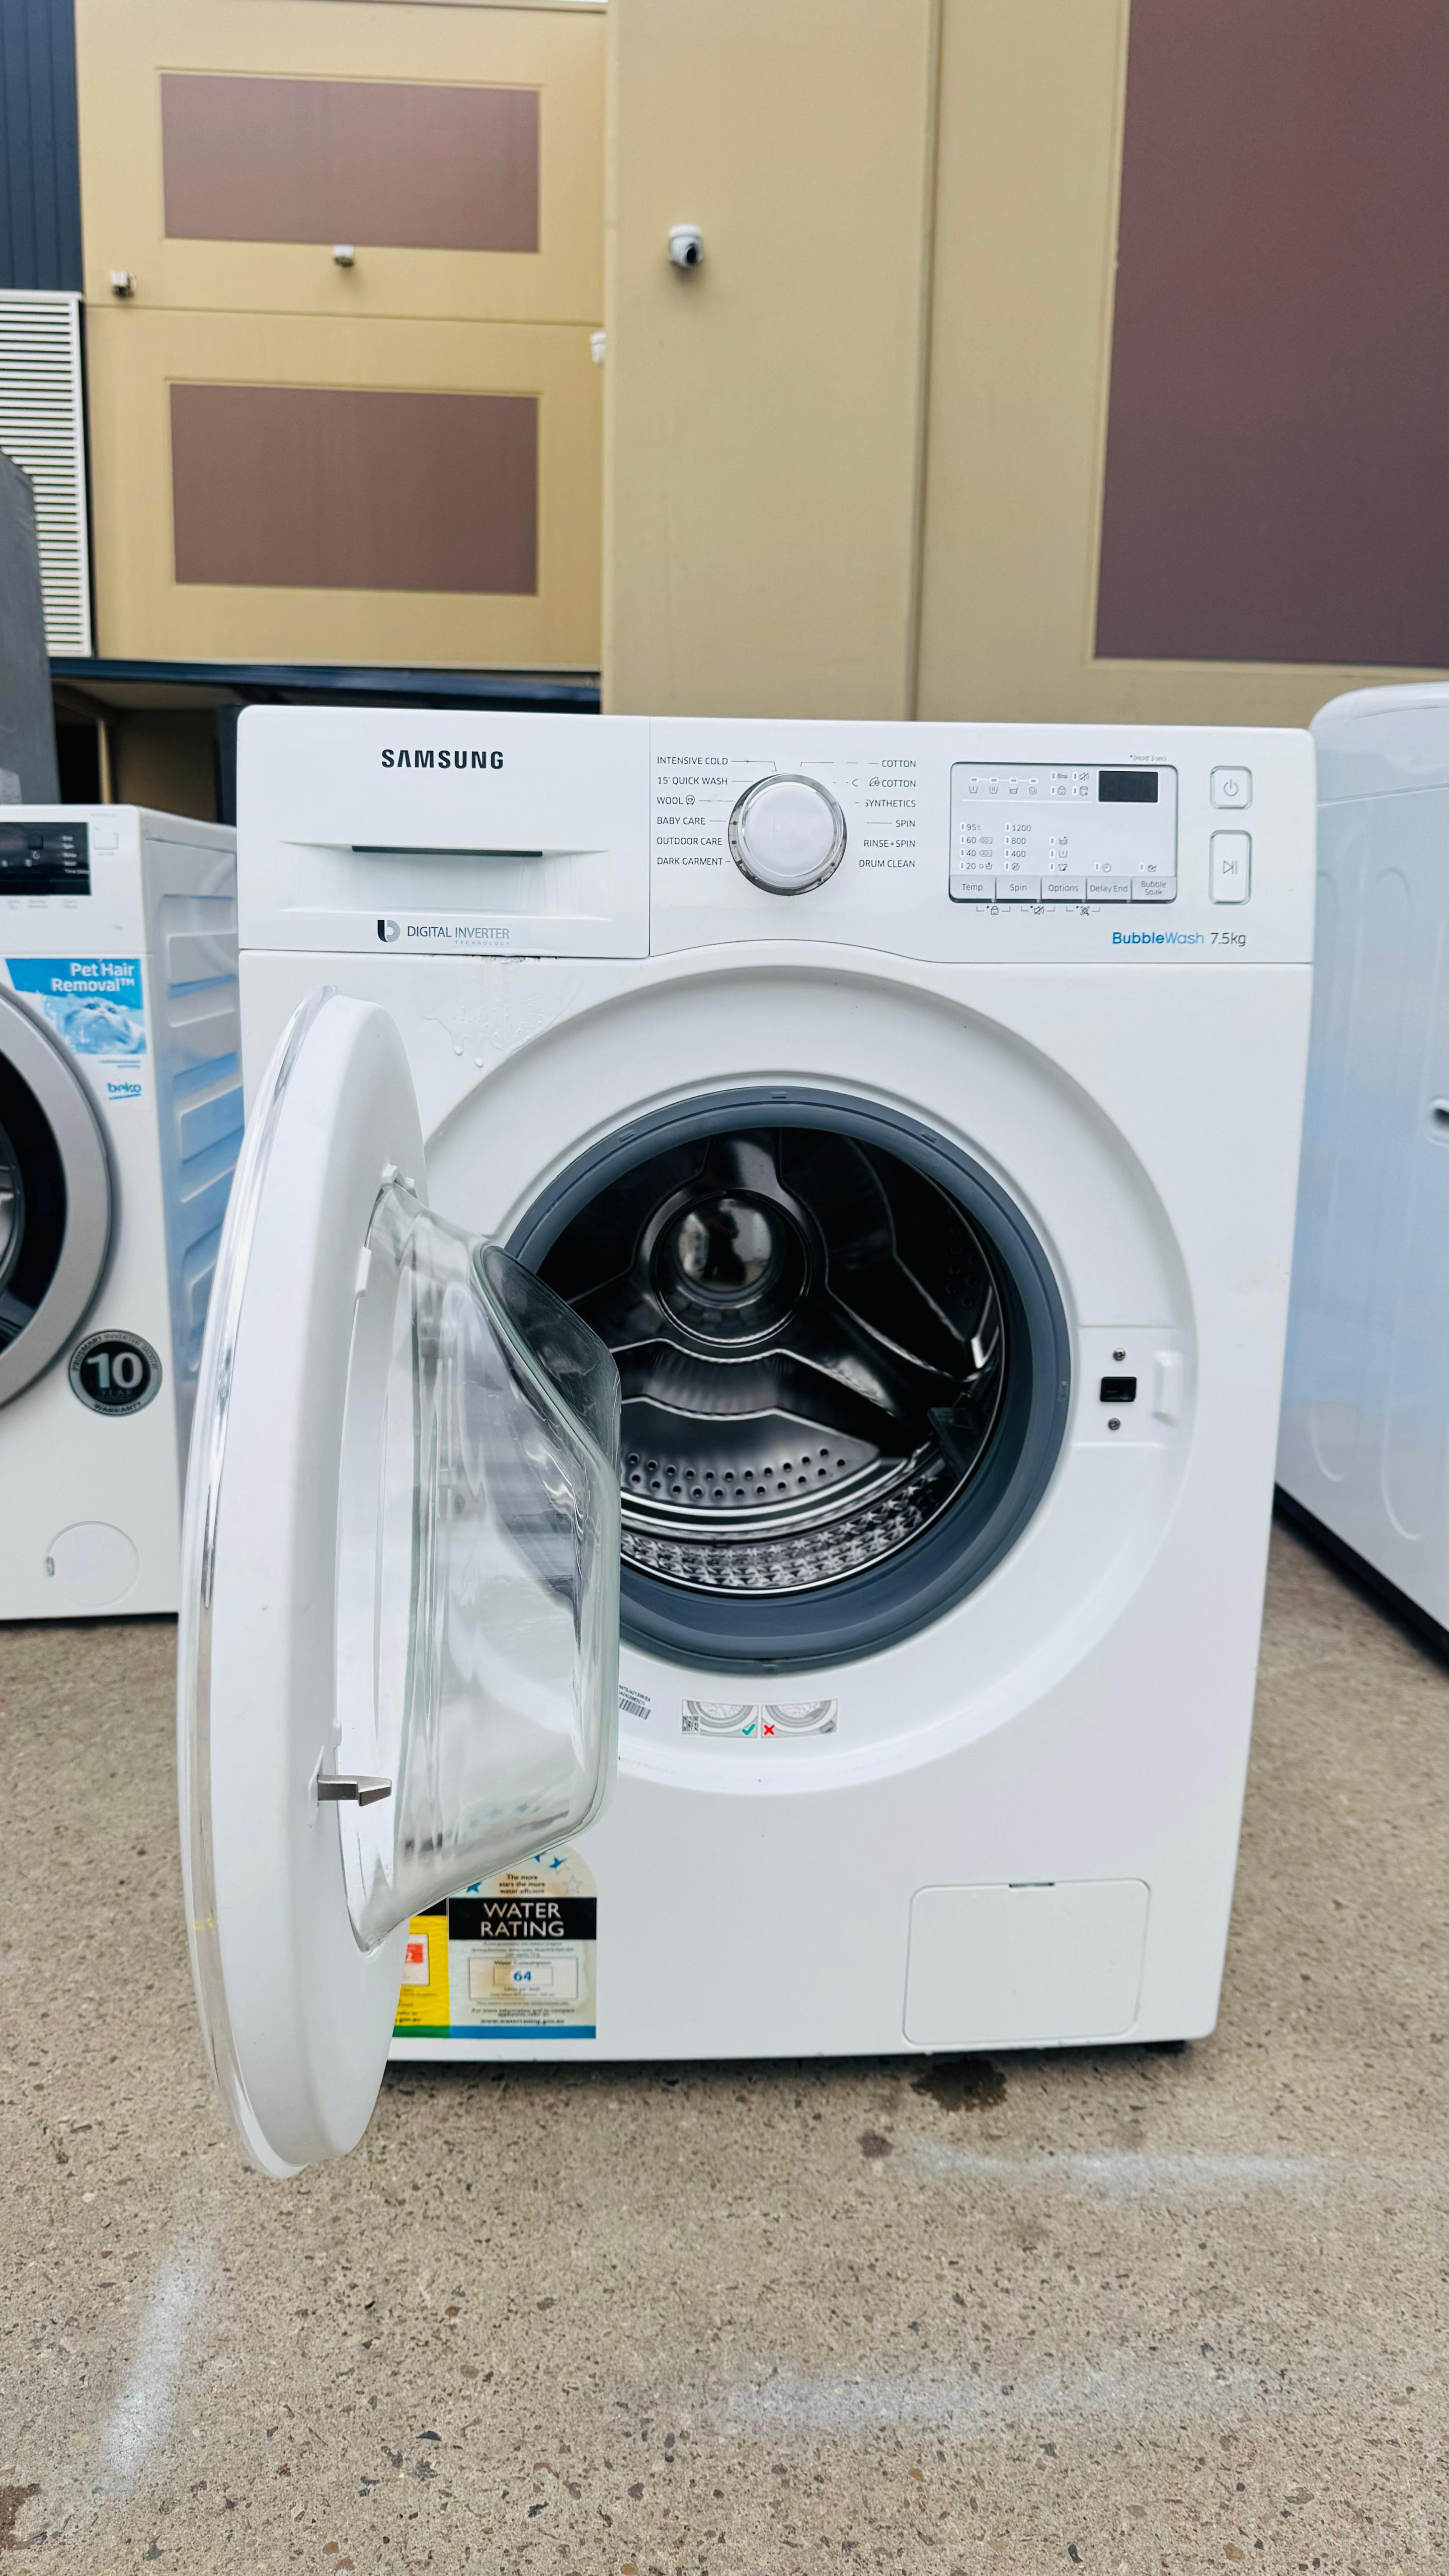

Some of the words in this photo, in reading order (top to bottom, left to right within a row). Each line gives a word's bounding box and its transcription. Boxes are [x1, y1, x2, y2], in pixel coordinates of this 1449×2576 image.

[382, 749, 503, 769] SAMSUNG
[673, 777, 699, 785] QUICK
[962, 883, 985, 893] Temp.
[1049, 884, 1079, 894] Options
[1090, 885, 1112, 893] Delay
[408, 926, 452, 937] DIGITAL
[455, 927, 509, 939] INVERTER
[1112, 932, 1203, 944] BubbleWash
[1211, 932, 1246, 947] 7.5kg
[70, 962, 99, 977] Pet
[100, 961, 135, 977] Hair
[87, 1352, 143, 1389] 10
[484, 1903, 561, 1918] WATER
[480, 1921, 564, 1937] RATING
[514, 1971, 531, 1981] 64
